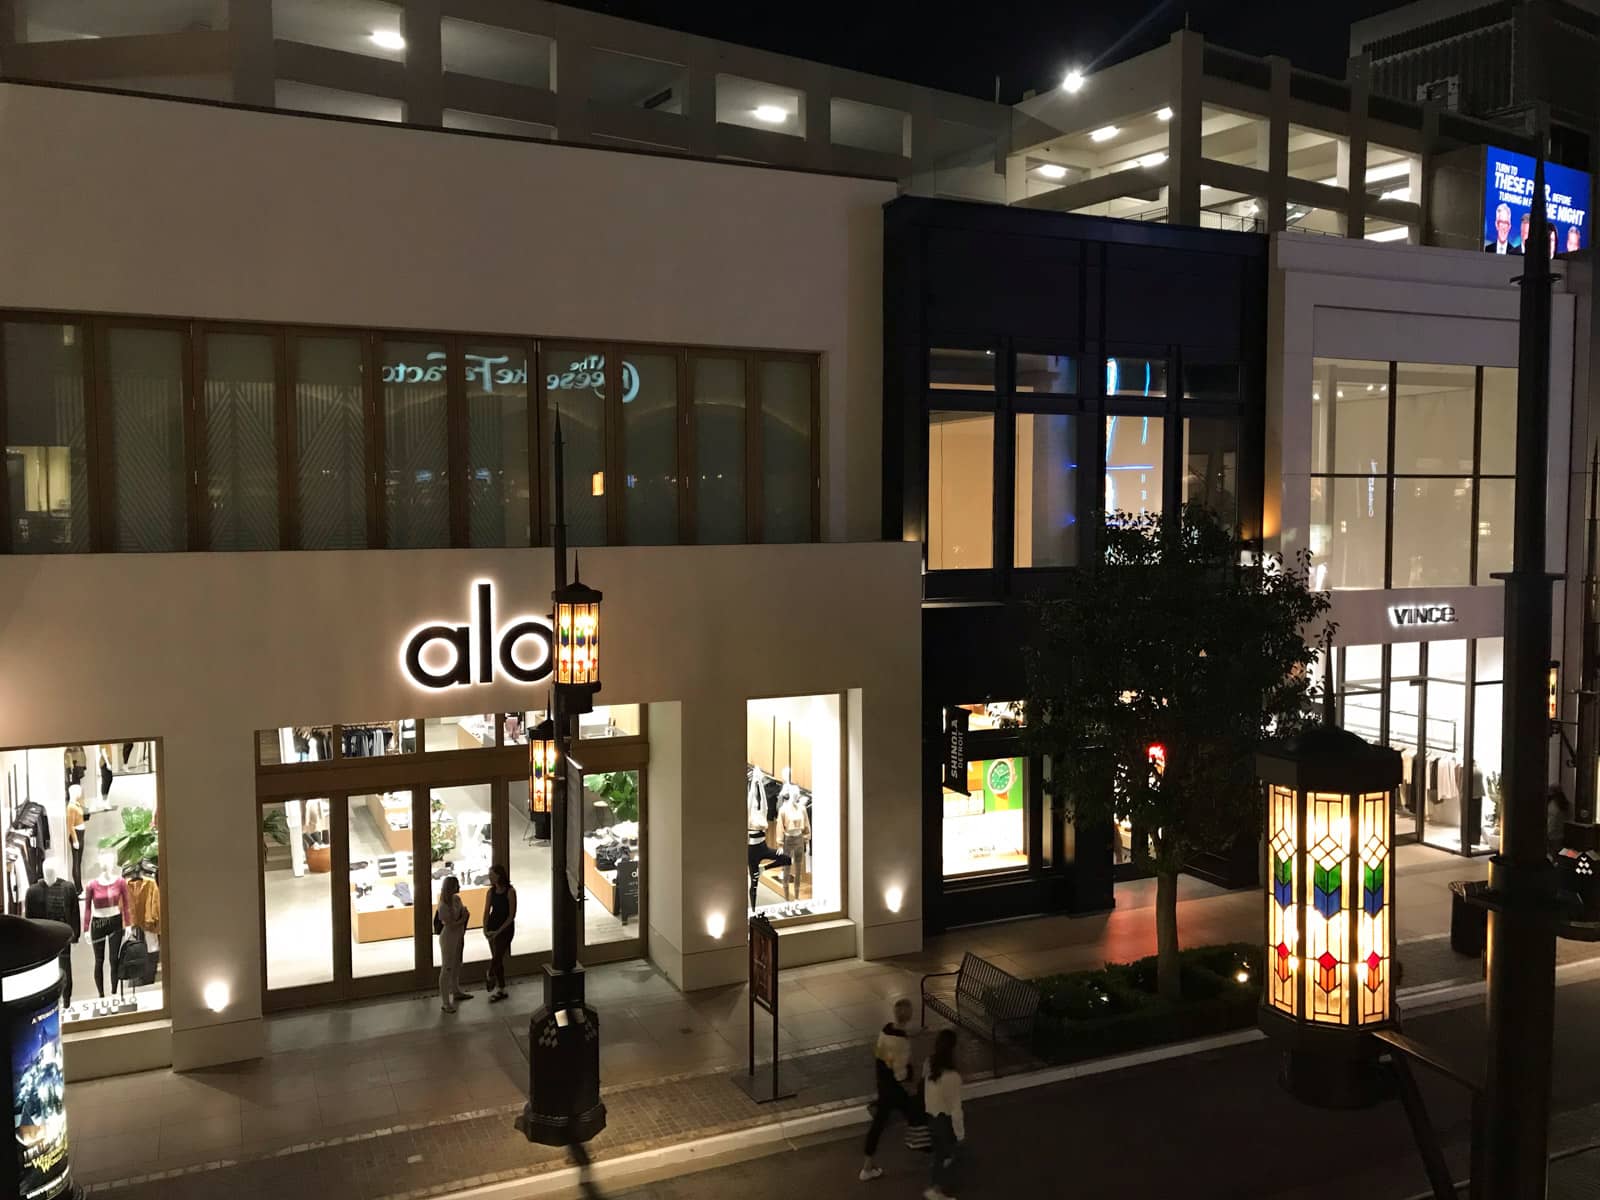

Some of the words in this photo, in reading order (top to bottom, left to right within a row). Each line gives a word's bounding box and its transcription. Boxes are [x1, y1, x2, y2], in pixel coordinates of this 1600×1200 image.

[1495, 161, 1511, 174] TURN
[1511, 165, 1518, 176] TO
[1494, 171, 1526, 194] THESE
[1552, 192, 1572, 206] BEFORE
[1557, 204, 1585, 226] NIGHT
[404, 583, 554, 688] alo
[82, 996, 137, 1011] STUDIO
